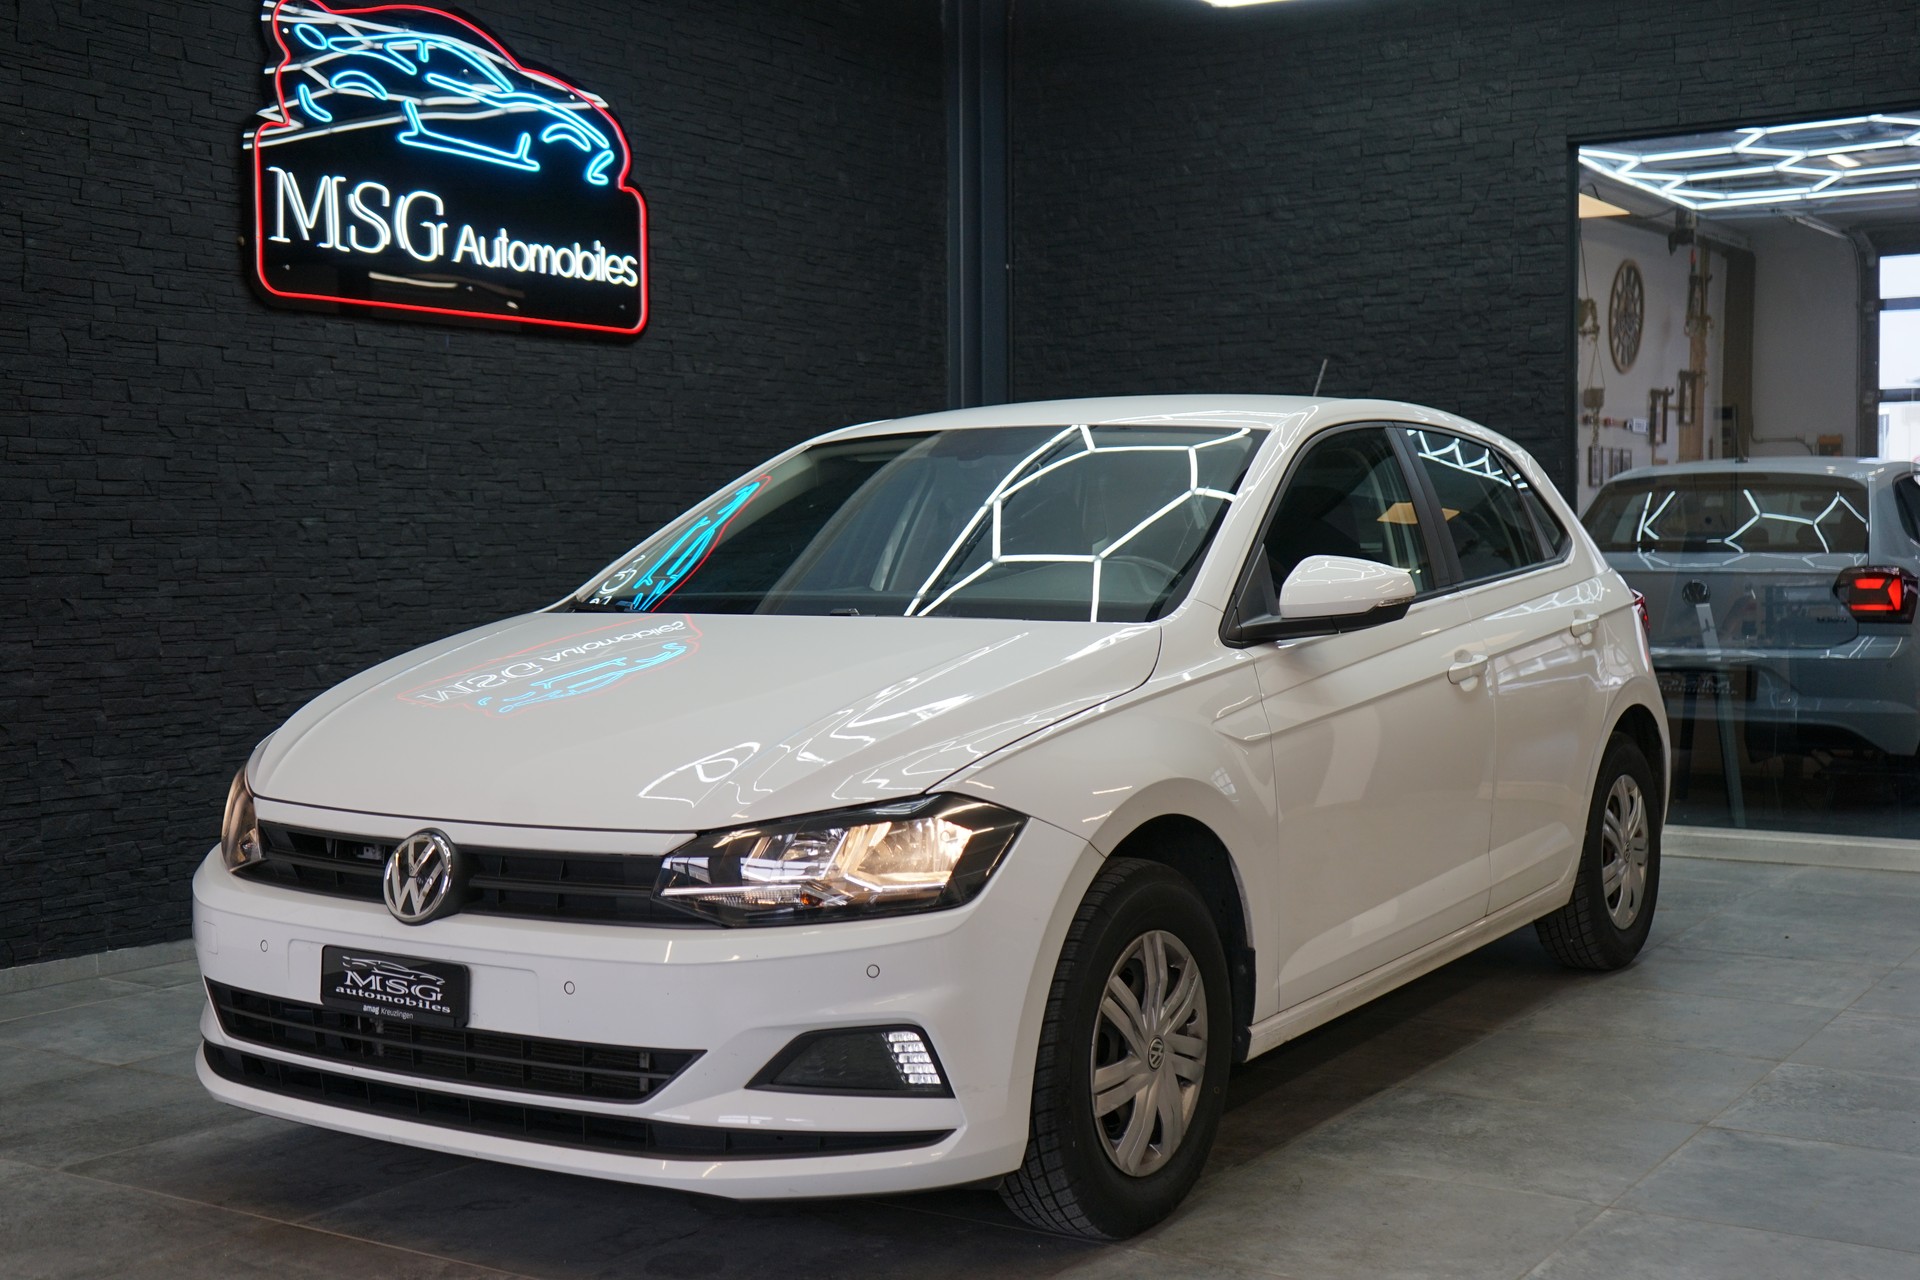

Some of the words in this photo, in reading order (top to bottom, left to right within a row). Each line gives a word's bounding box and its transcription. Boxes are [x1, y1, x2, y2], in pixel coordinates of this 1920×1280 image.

[267, 166, 448, 263] MSG
[452, 223, 639, 288] Automobiles
[335, 985, 451, 1014] automobiles
[344, 969, 444, 1001] MSG
[363, 1004, 380, 1016] amag
